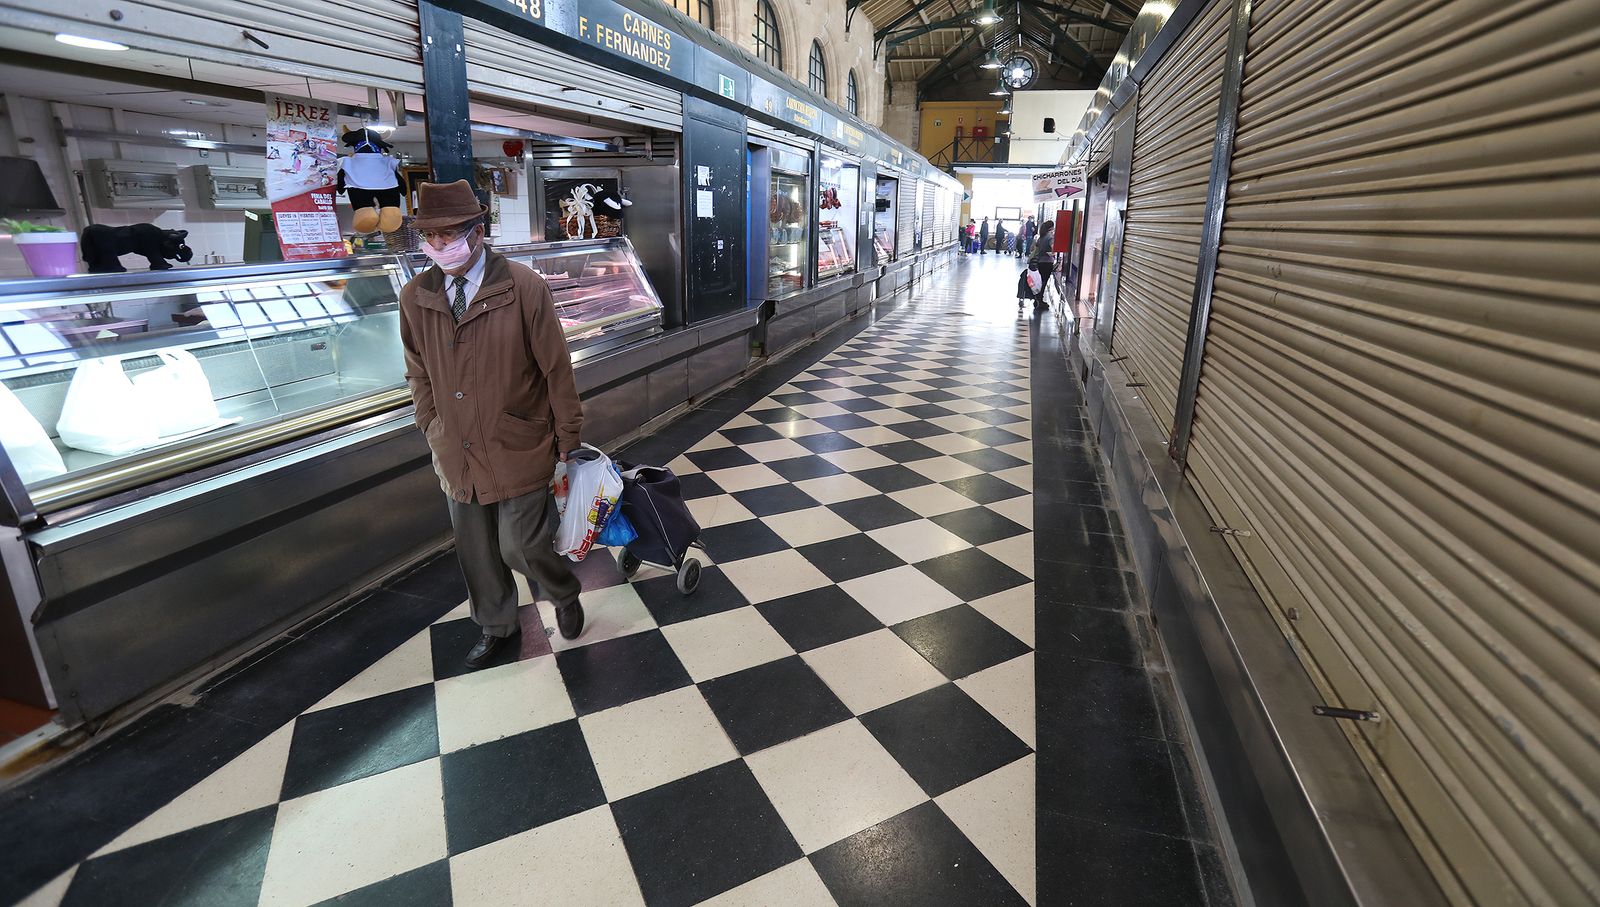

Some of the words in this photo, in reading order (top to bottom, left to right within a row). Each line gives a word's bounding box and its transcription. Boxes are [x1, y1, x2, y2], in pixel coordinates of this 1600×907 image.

[579, 16, 591, 39] F.
[596, 23, 671, 71] FERNANDEZ
[623, 12, 671, 51] CARNES
[275, 97, 330, 122] JEREZ
[764, 99, 773, 113] 49
[1032, 169, 1082, 181] CHICHARRONES
